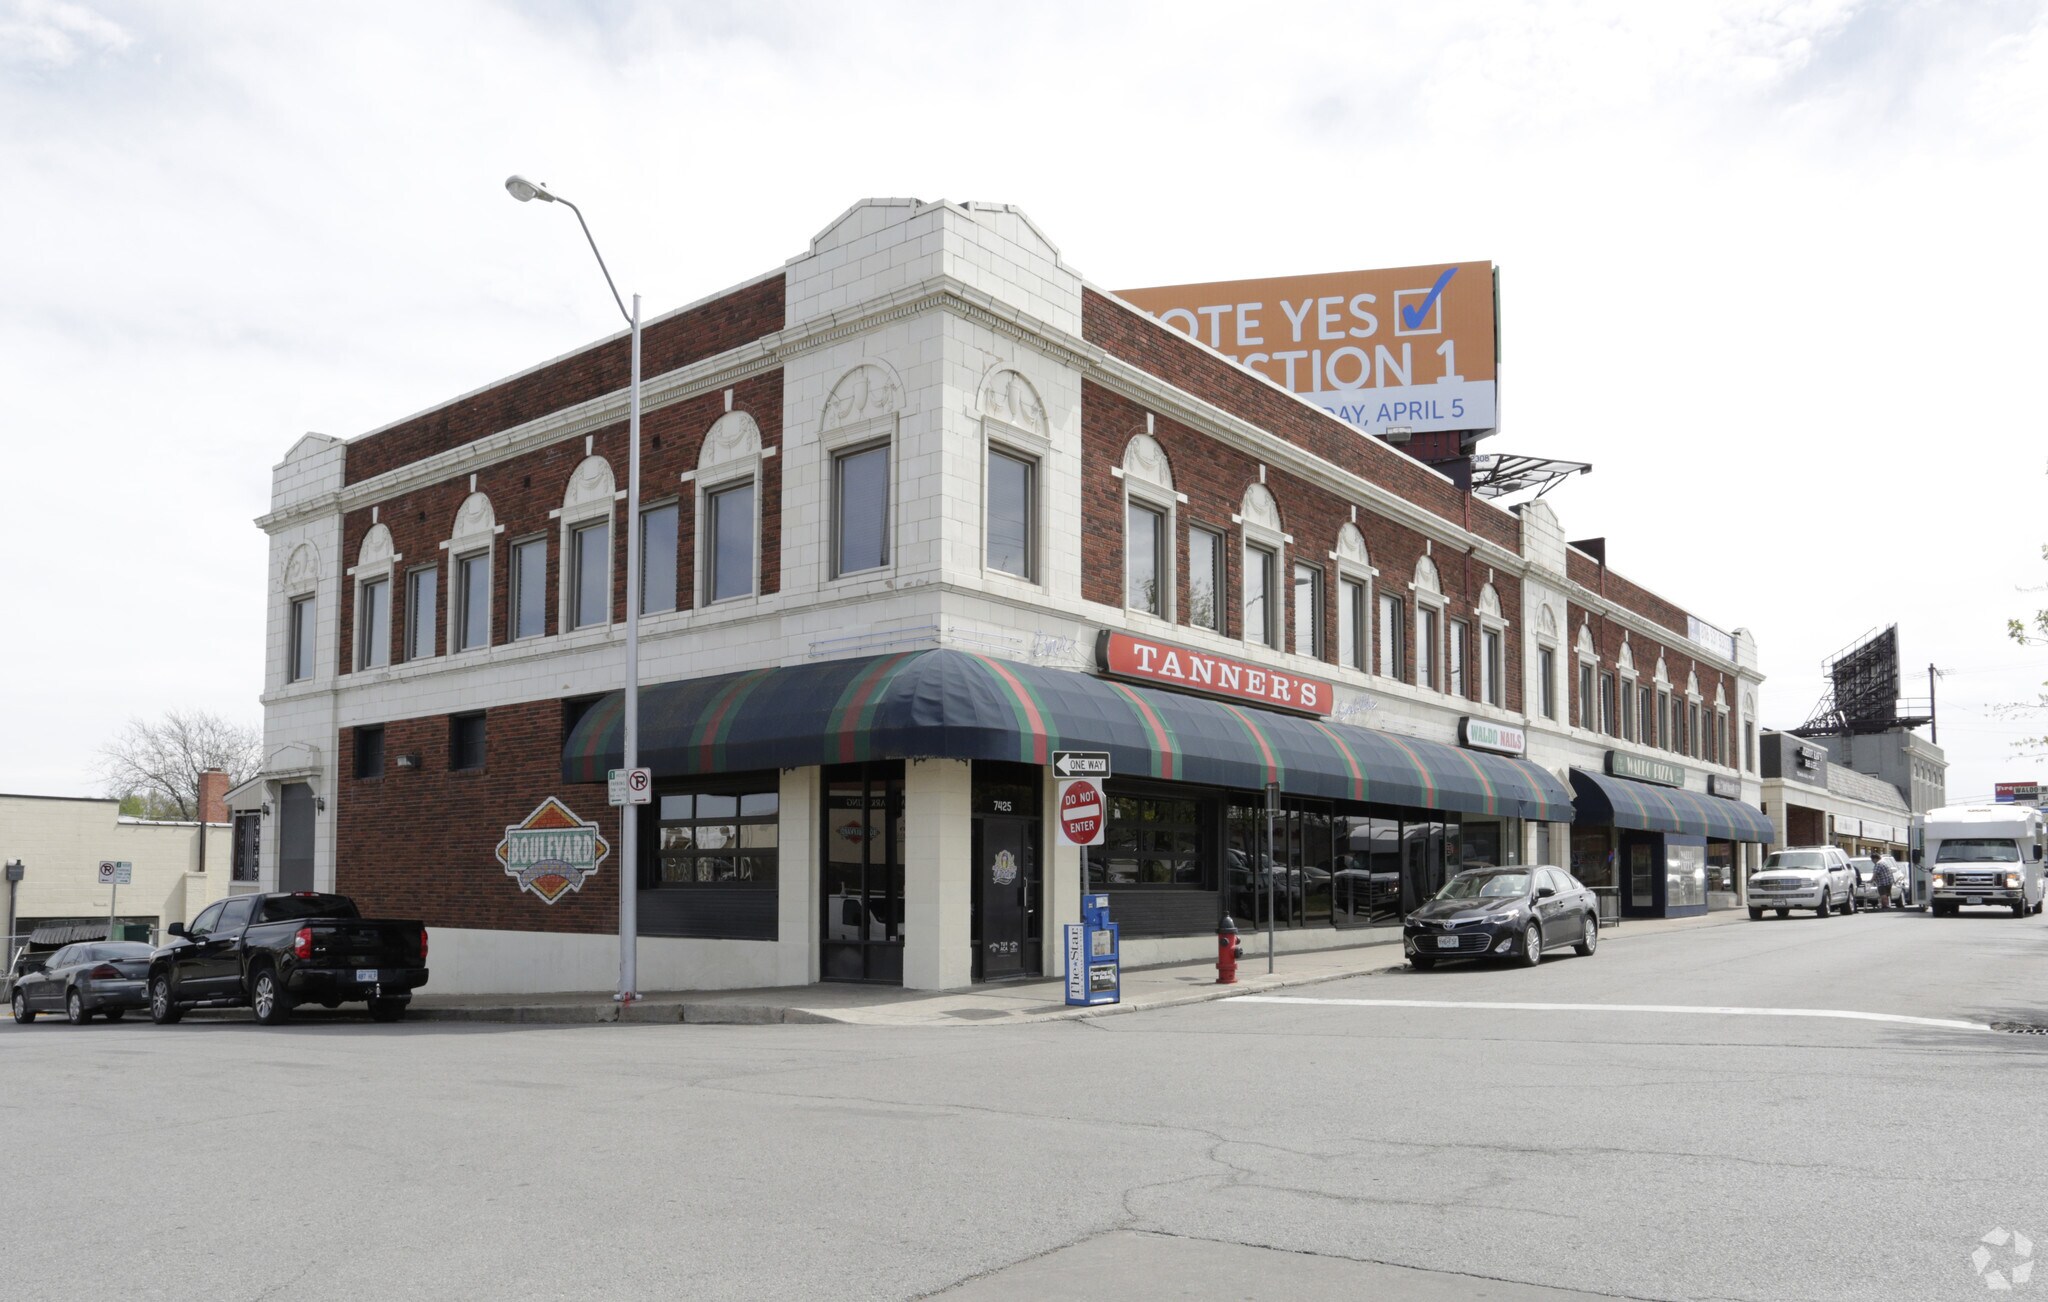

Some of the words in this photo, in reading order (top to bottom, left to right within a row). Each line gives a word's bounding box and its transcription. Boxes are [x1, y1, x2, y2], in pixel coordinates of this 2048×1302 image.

[1148, 302, 1264, 348] OTE
[1280, 293, 1378, 342] YES
[1436, 340, 1465, 385] 1
[1376, 400, 1444, 423] APRIL
[1452, 398, 1465, 418] 5
[1134, 643, 1317, 707] TANNER'S
[1471, 724, 1498, 745] WALDO
[1501, 730, 1522, 750] NAILS
[1070, 760, 1086, 770] ONE
[1088, 760, 1103, 770] WAY
[1653, 763, 1674, 783] PIZZA
[1065, 794, 1076, 806] DO
[1080, 790, 1095, 803] NOT
[2015, 785, 2039, 793] WALDO
[993, 800, 1012, 812] 7425
[1070, 820, 1095, 833] ENTER
[511, 834, 593, 864] BOULEVARD
[1070, 928, 1080, 961] Star
[1071, 968, 1080, 997] The
